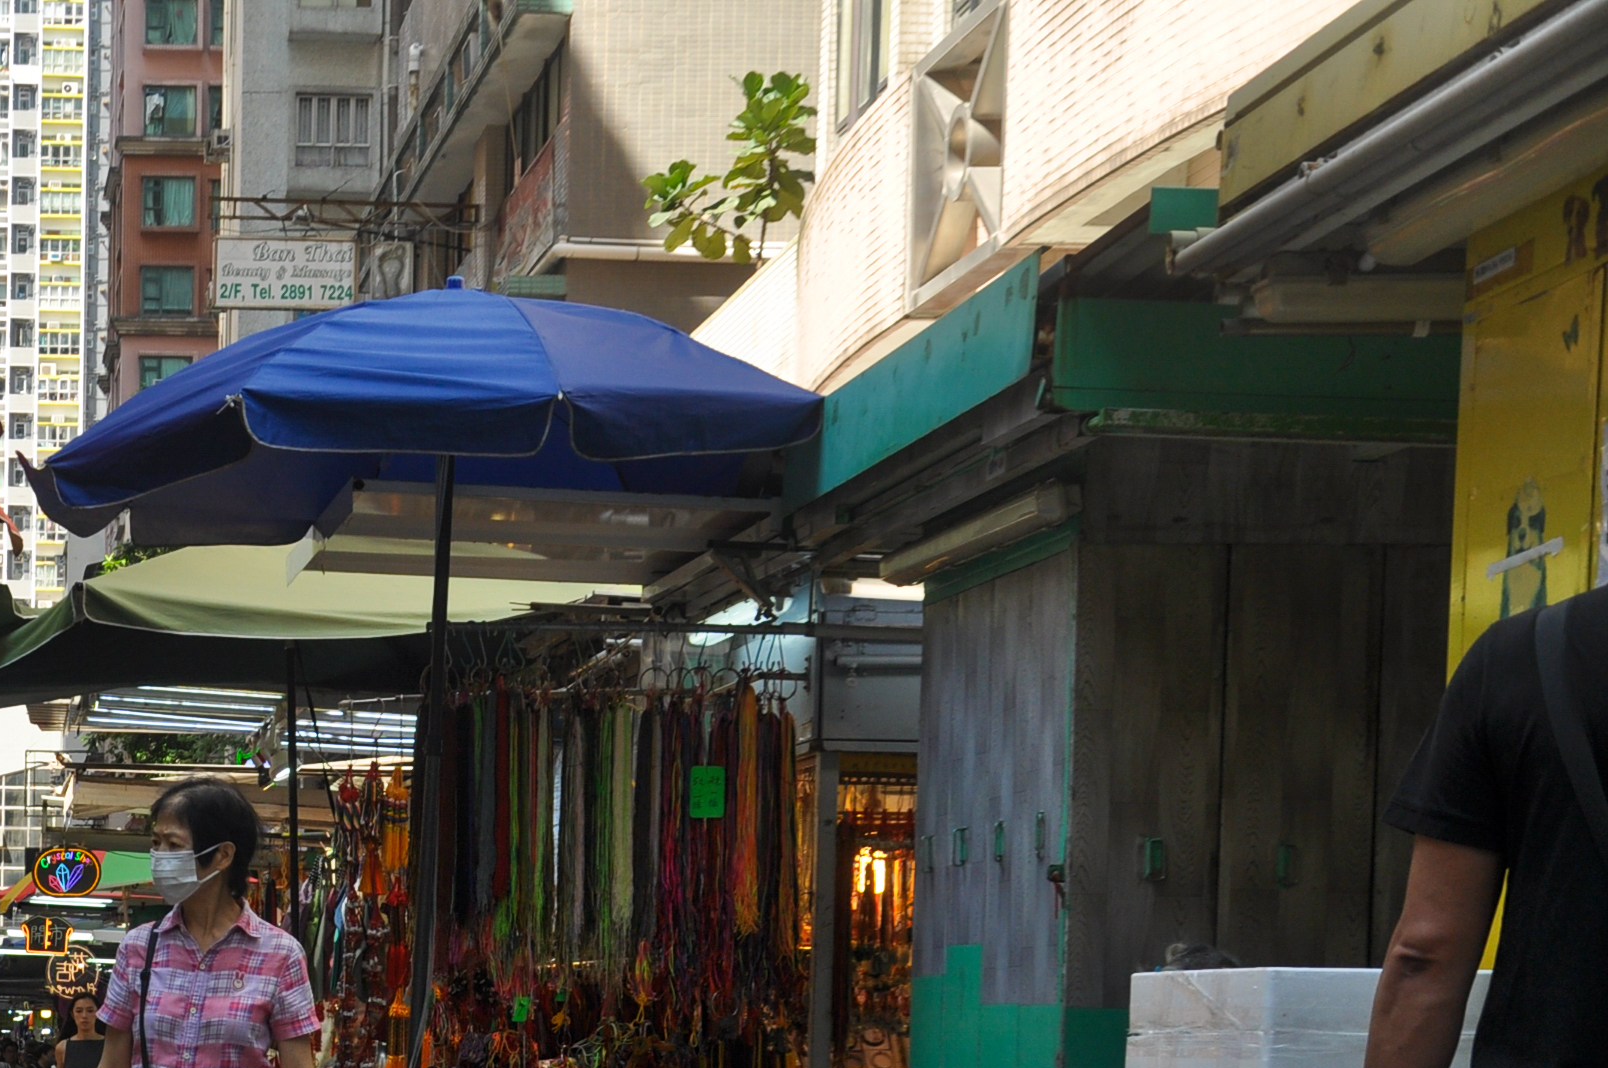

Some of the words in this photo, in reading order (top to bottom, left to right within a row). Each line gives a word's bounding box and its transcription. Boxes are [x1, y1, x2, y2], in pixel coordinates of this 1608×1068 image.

[253, 241, 296, 263] Ban
[304, 243, 354, 263] Thai
[221, 262, 271, 281] Beauty
[275, 265, 287, 280] &
[290, 265, 352, 282] Massage
[220, 283, 246, 302] 2/F,
[251, 284, 275, 300] Tel.
[280, 284, 313, 301] 2891
[320, 284, 353, 301] 7224
[41, 850, 75, 869] Crystal
